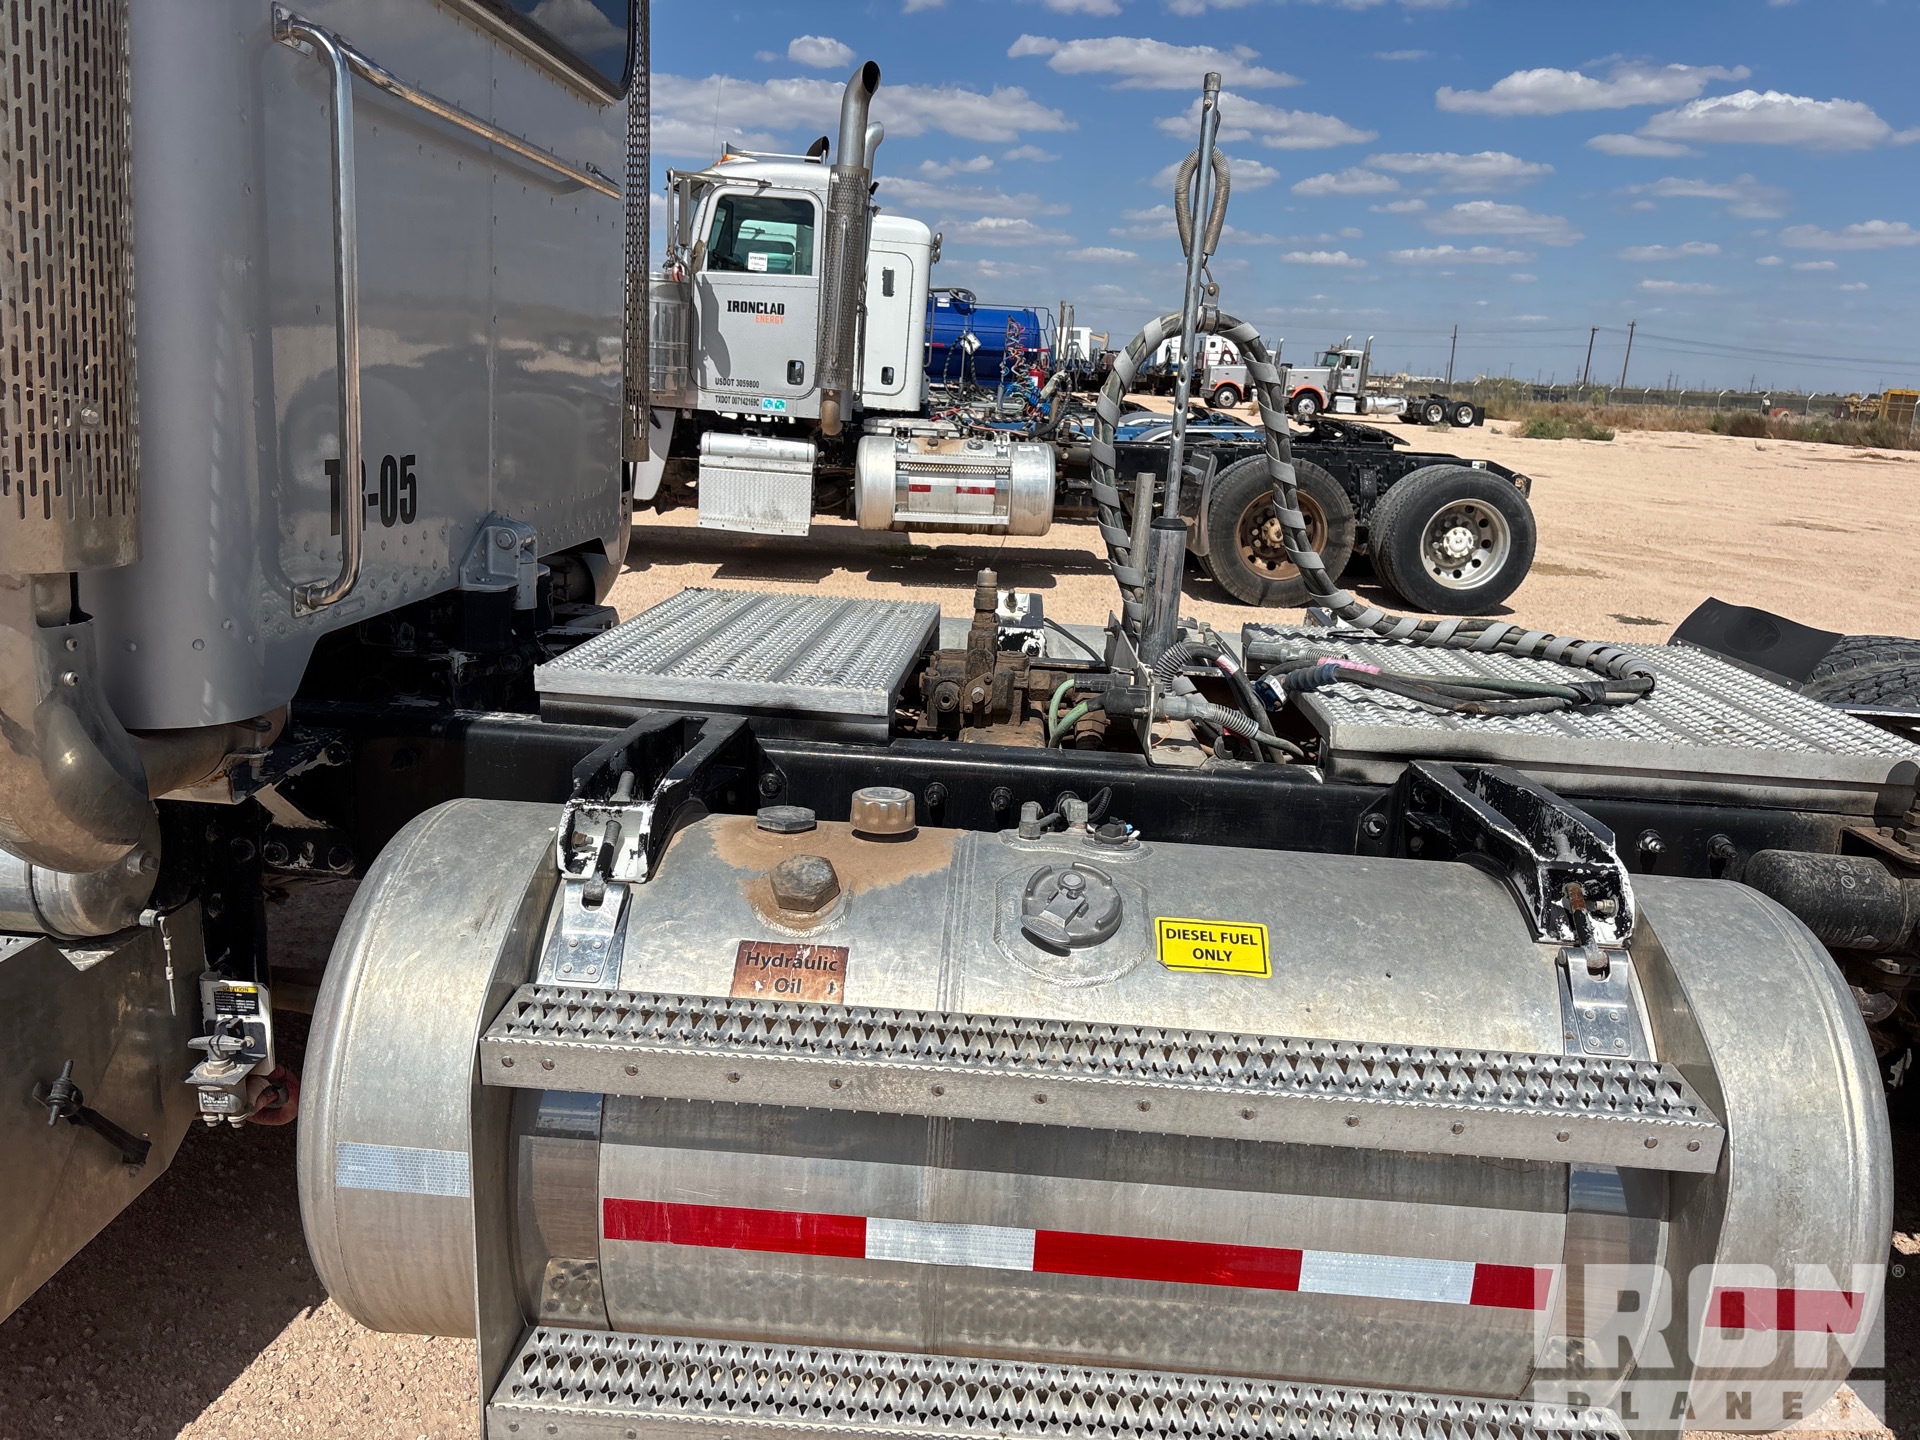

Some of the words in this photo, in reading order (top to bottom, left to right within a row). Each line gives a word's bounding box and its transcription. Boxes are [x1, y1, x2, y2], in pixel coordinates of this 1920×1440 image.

[727, 300, 785, 315] IRONCLAD
[755, 315, 784, 324] ENERGY
[715, 377, 735, 387] USDOT
[715, 395, 731, 404] TXDOT
[1166, 928, 1217, 942] DIESEL
[1221, 932, 1258, 946] FUEL
[745, 951, 838, 972] Hydraulic
[1192, 948, 1233, 962] ONLY
[774, 978, 802, 993] Oil
